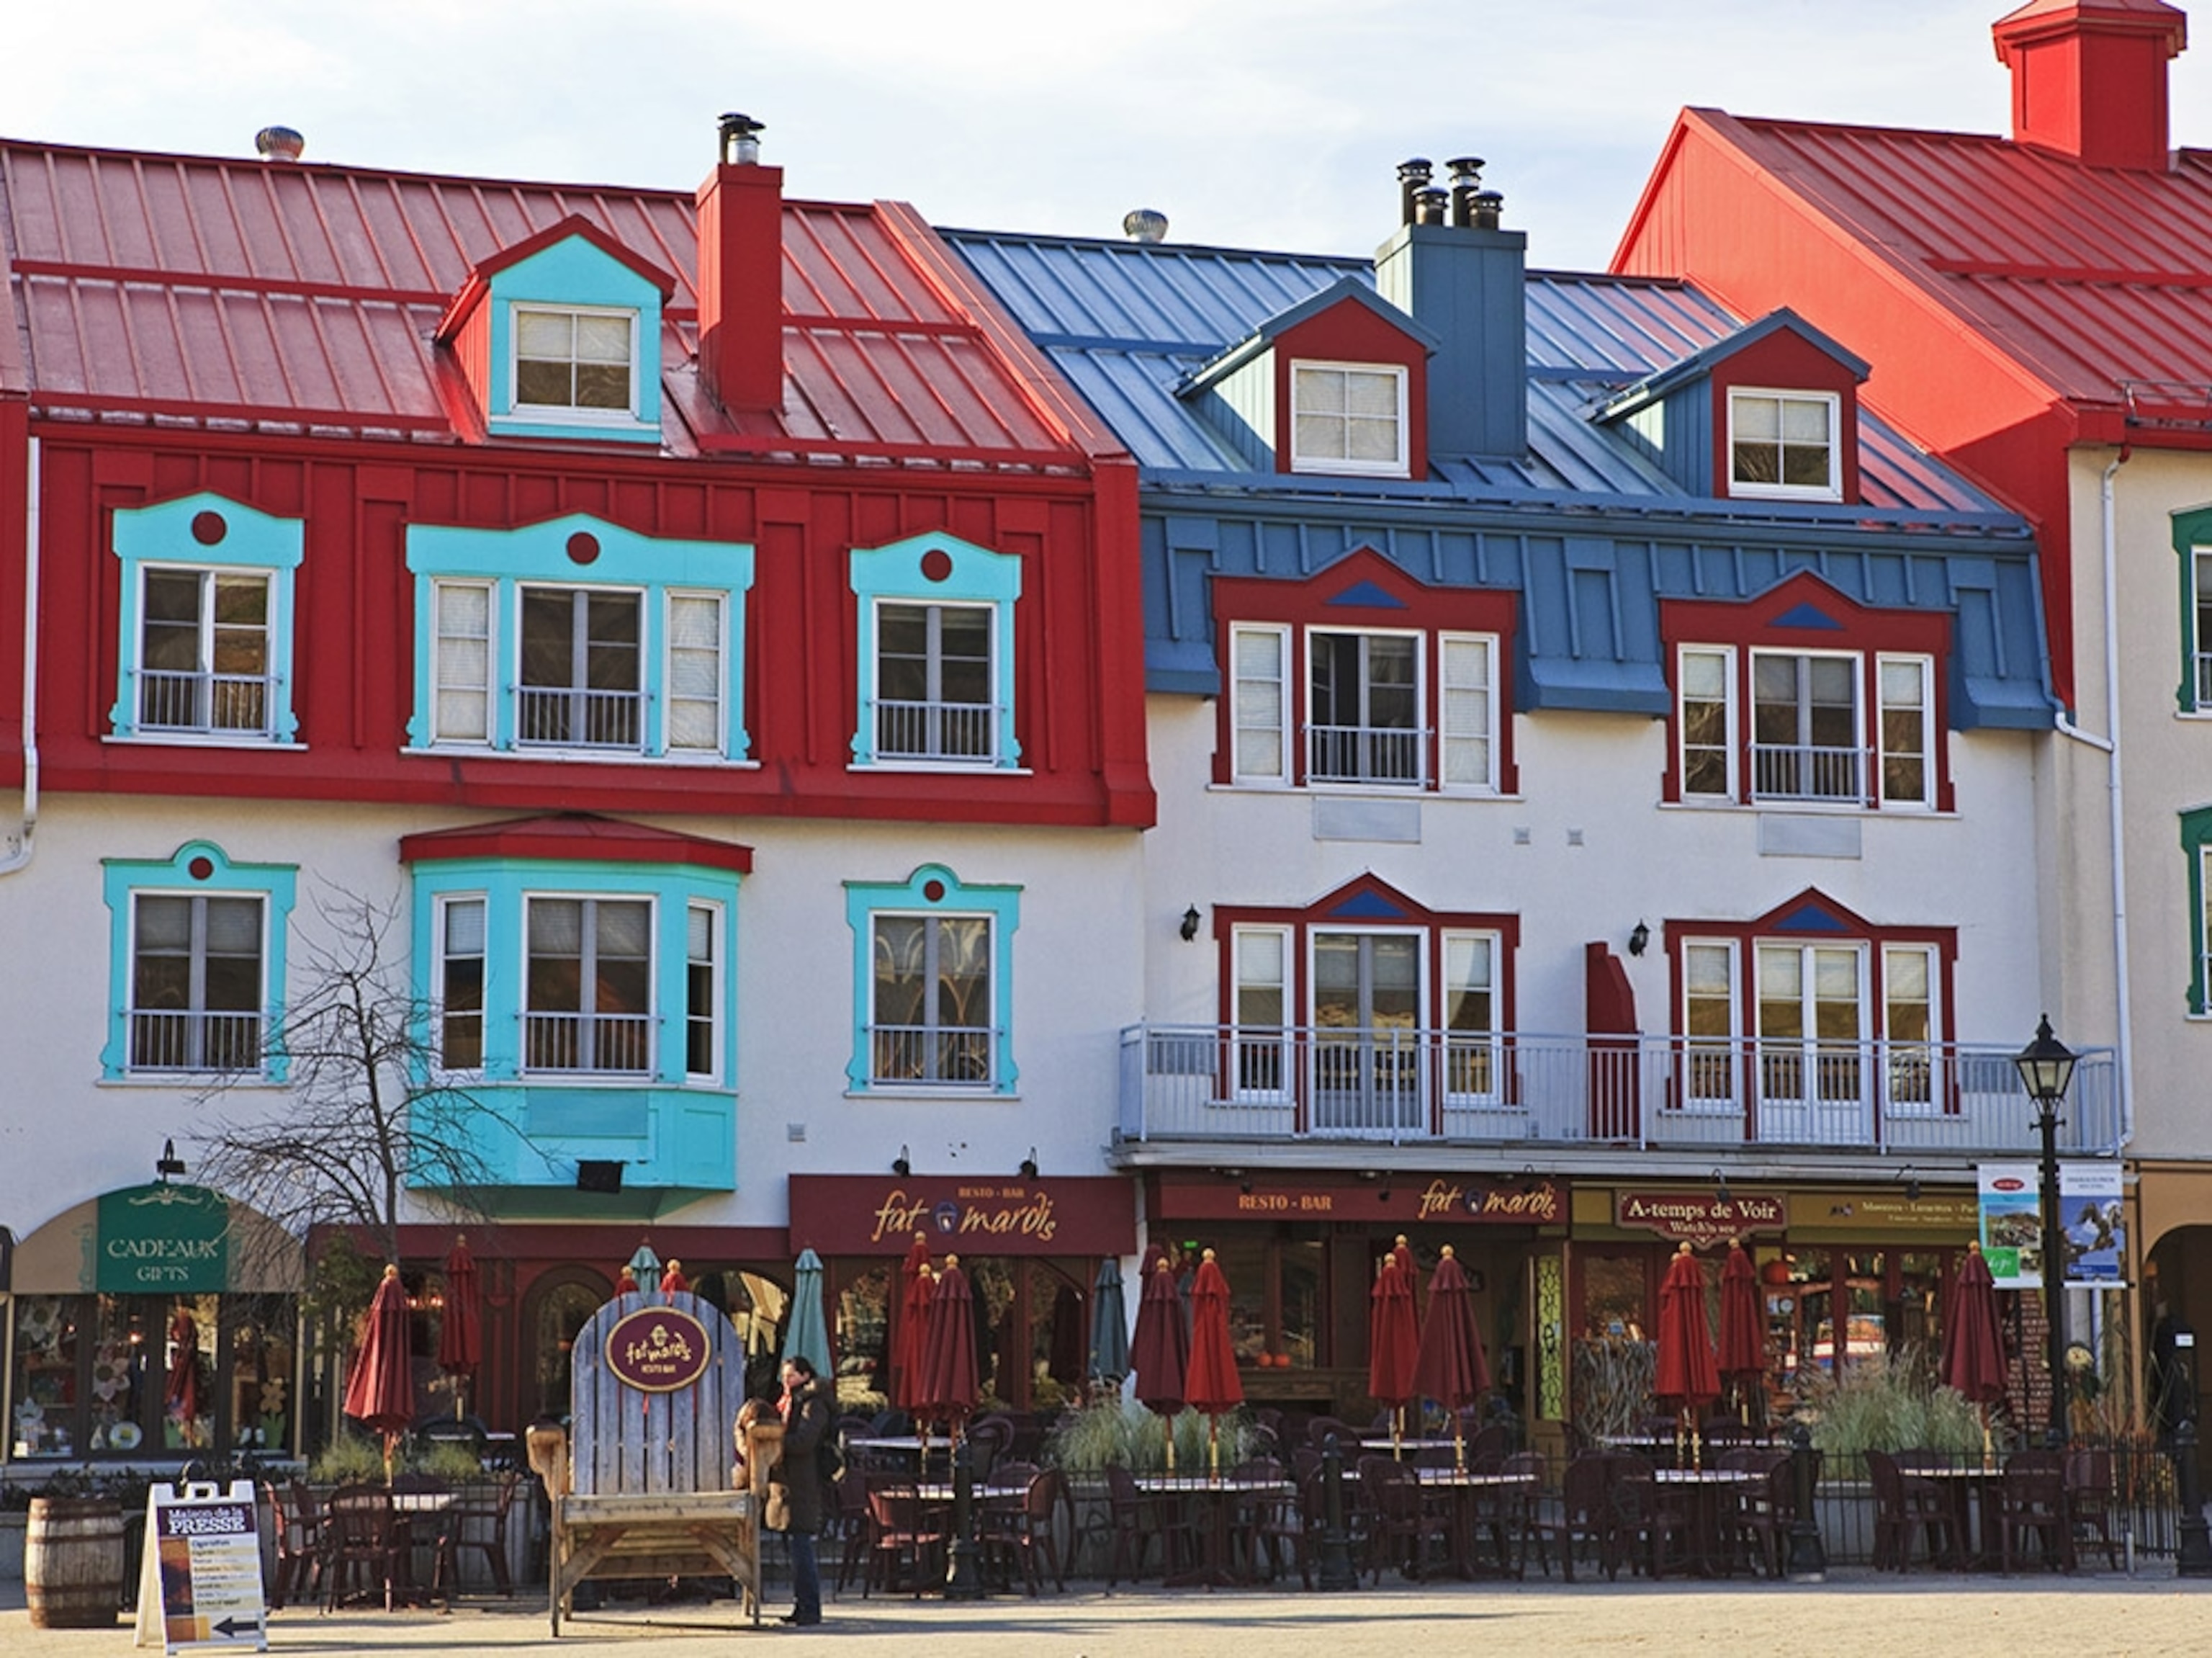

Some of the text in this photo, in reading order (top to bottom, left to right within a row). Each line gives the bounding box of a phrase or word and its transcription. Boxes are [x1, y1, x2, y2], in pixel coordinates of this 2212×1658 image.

[958, 1187, 994, 1198] RESTO
[1002, 1187, 1025, 1198] BAR
[1417, 1178, 1462, 1219] fat
[1238, 1194, 1289, 1210] RESTO
[1300, 1194, 1332, 1211] BAR
[1710, 1201, 1733, 1219] de
[1737, 1200, 1778, 1219] Voir
[870, 1189, 930, 1242] fat
[107, 1238, 219, 1258] CADEAUX
[136, 1265, 190, 1281] GIFTS
[214, 1506, 230, 1518] de
[168, 1516, 246, 1536] PRESSE
